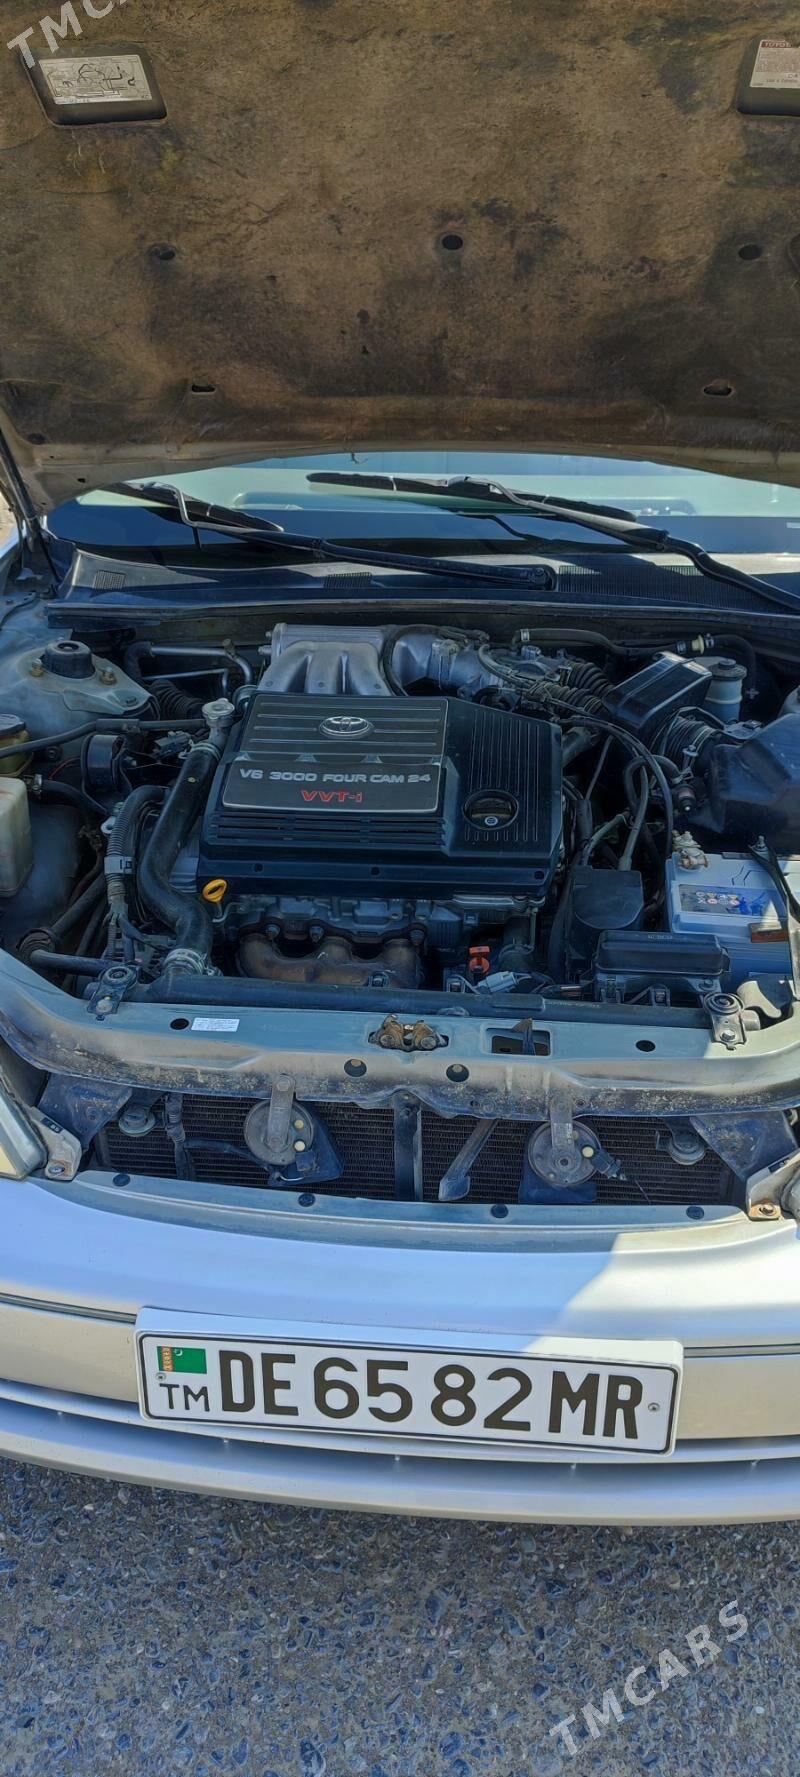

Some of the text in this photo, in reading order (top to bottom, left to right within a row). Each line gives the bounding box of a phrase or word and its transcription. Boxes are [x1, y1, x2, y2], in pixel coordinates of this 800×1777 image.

[240, 768, 431, 783] V6 3000 FOUR CAM 24
[159, 1383, 210, 1412] TM
[218, 1349, 300, 1416] DE
[548, 1371, 644, 1439] MR
